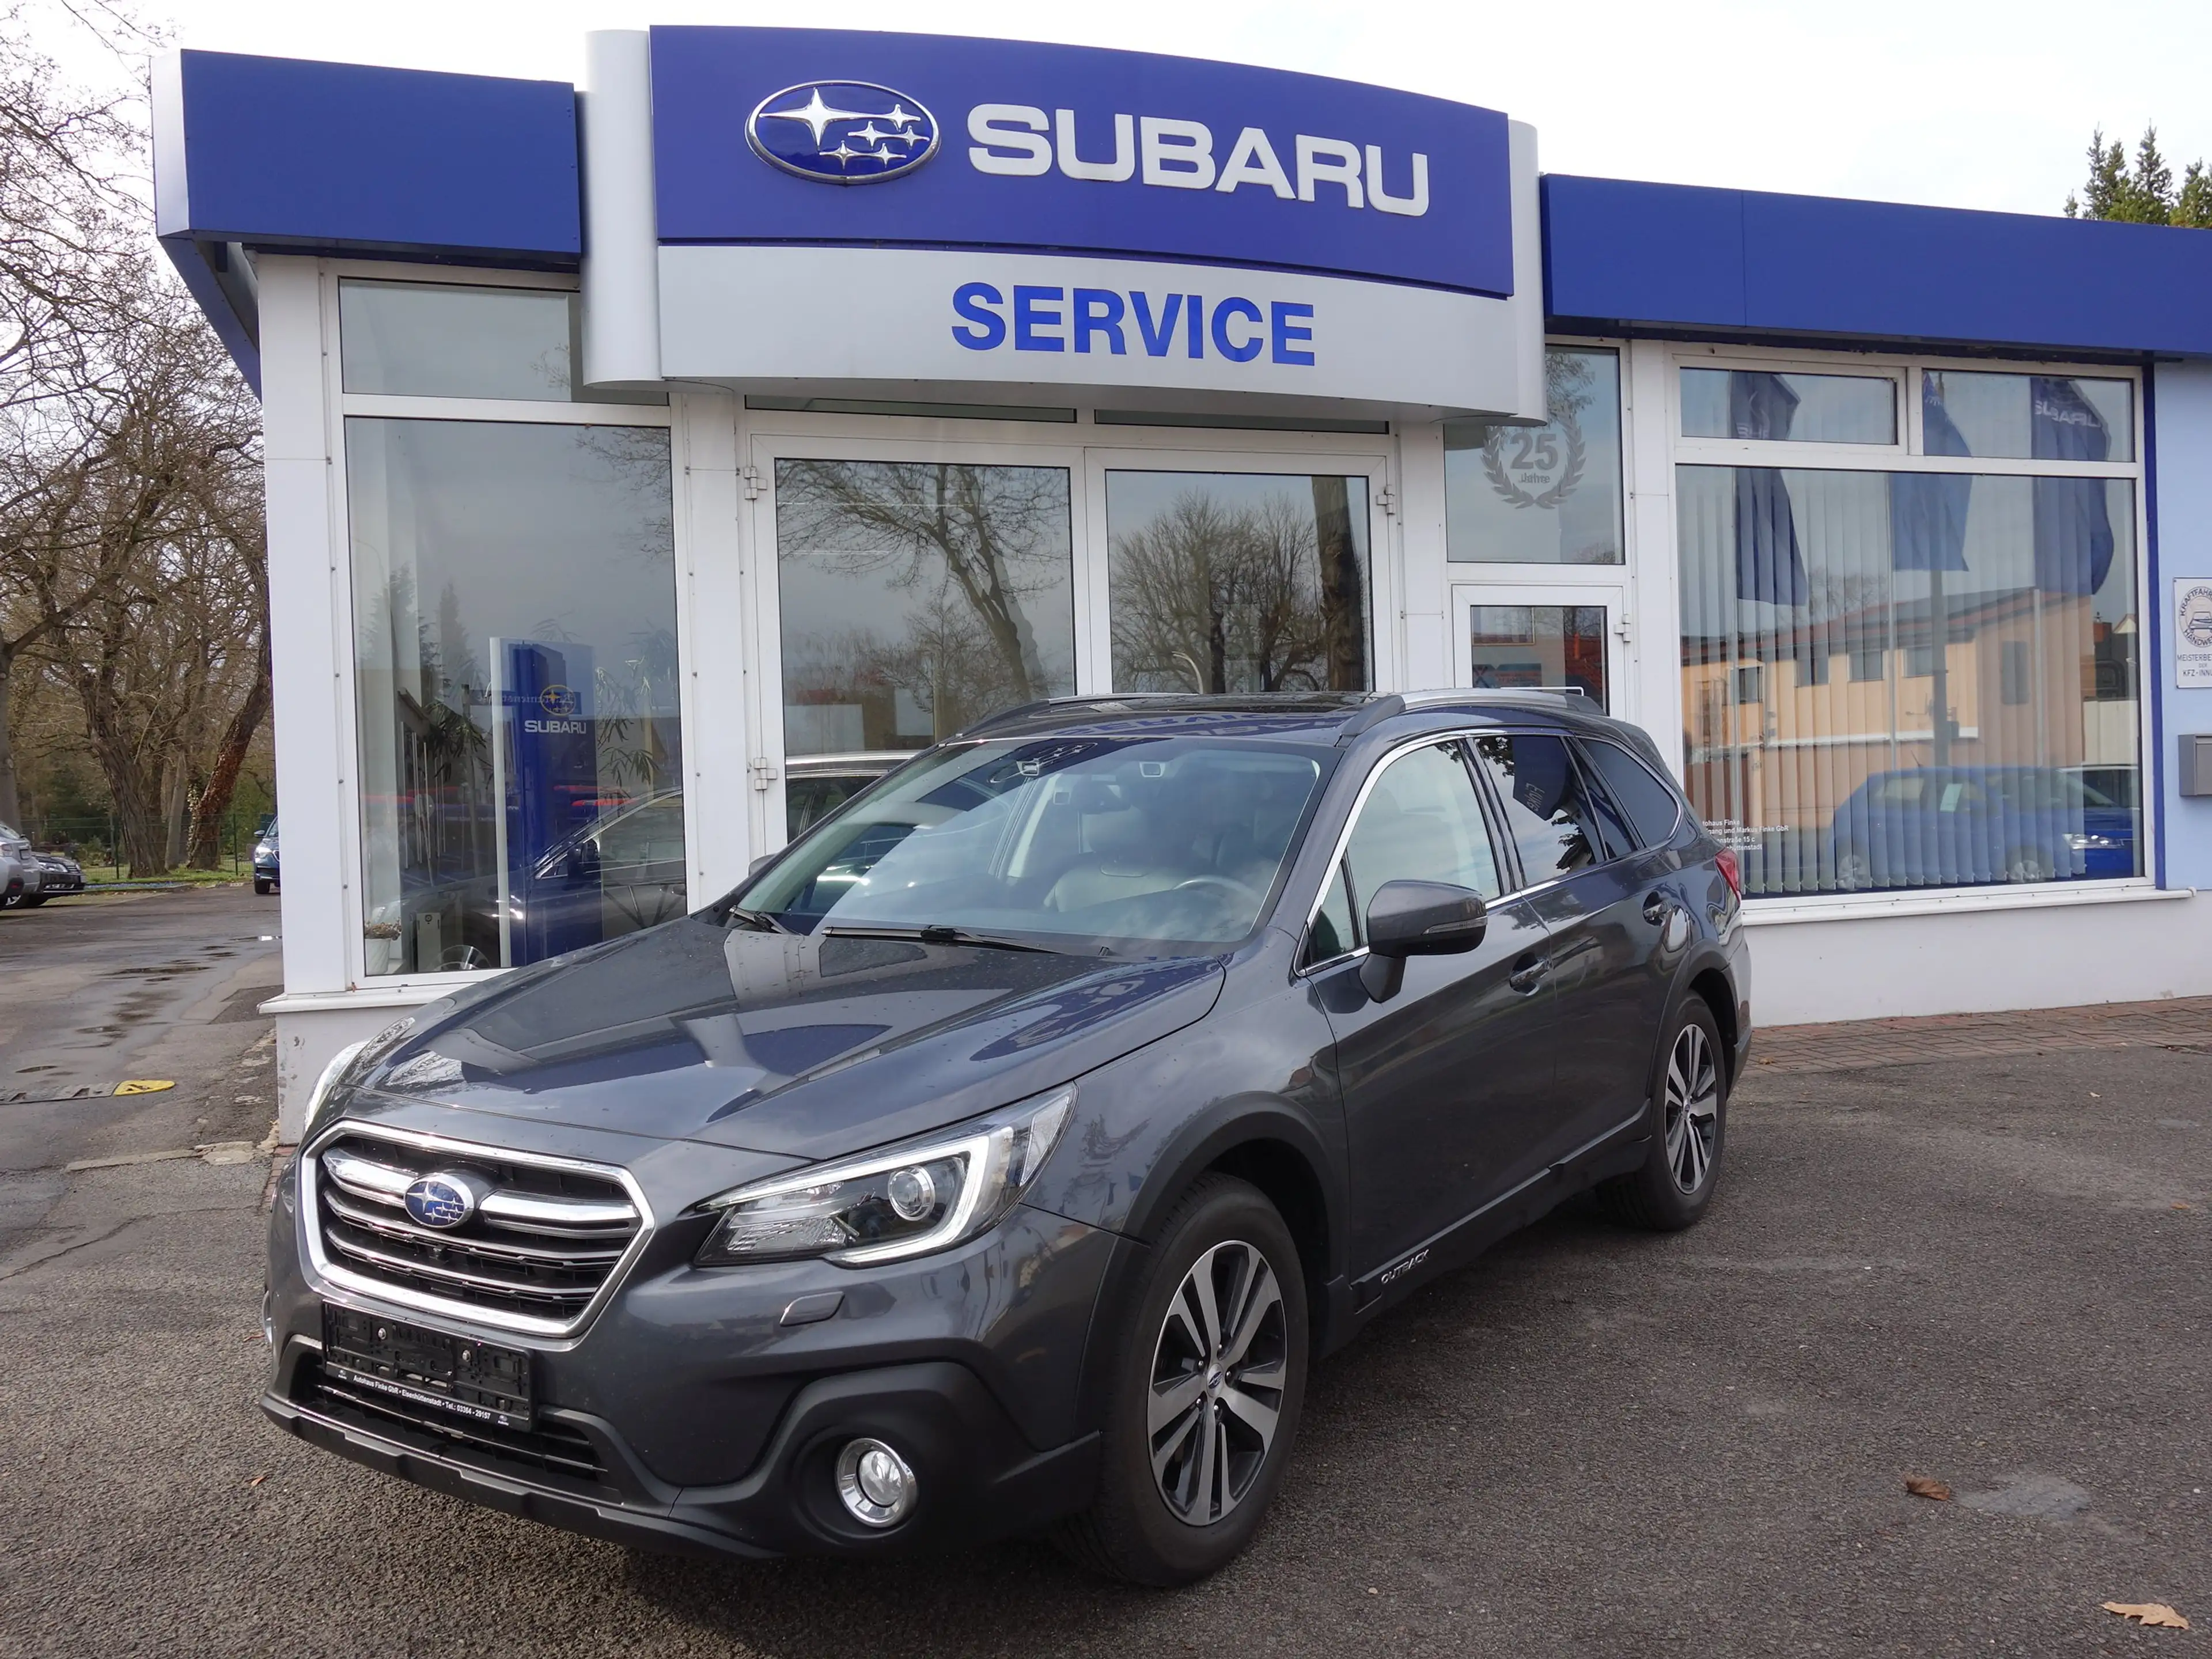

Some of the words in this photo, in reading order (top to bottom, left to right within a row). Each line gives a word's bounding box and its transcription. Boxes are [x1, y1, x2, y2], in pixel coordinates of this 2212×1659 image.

[967, 104, 1429, 217] SUBARU
[951, 282, 1315, 366] SERVICE
[1510, 432, 1558, 471] 25
[1518, 473, 1550, 483] Jahre
[525, 720, 586, 734] SUBARU
[353, 1374, 375, 1387] Autohaus
[375, 1381, 388, 1391] Finke
[388, 1385, 399, 1394] GbR
[402, 1389, 442, 1407] Eisenhüttenstadt
